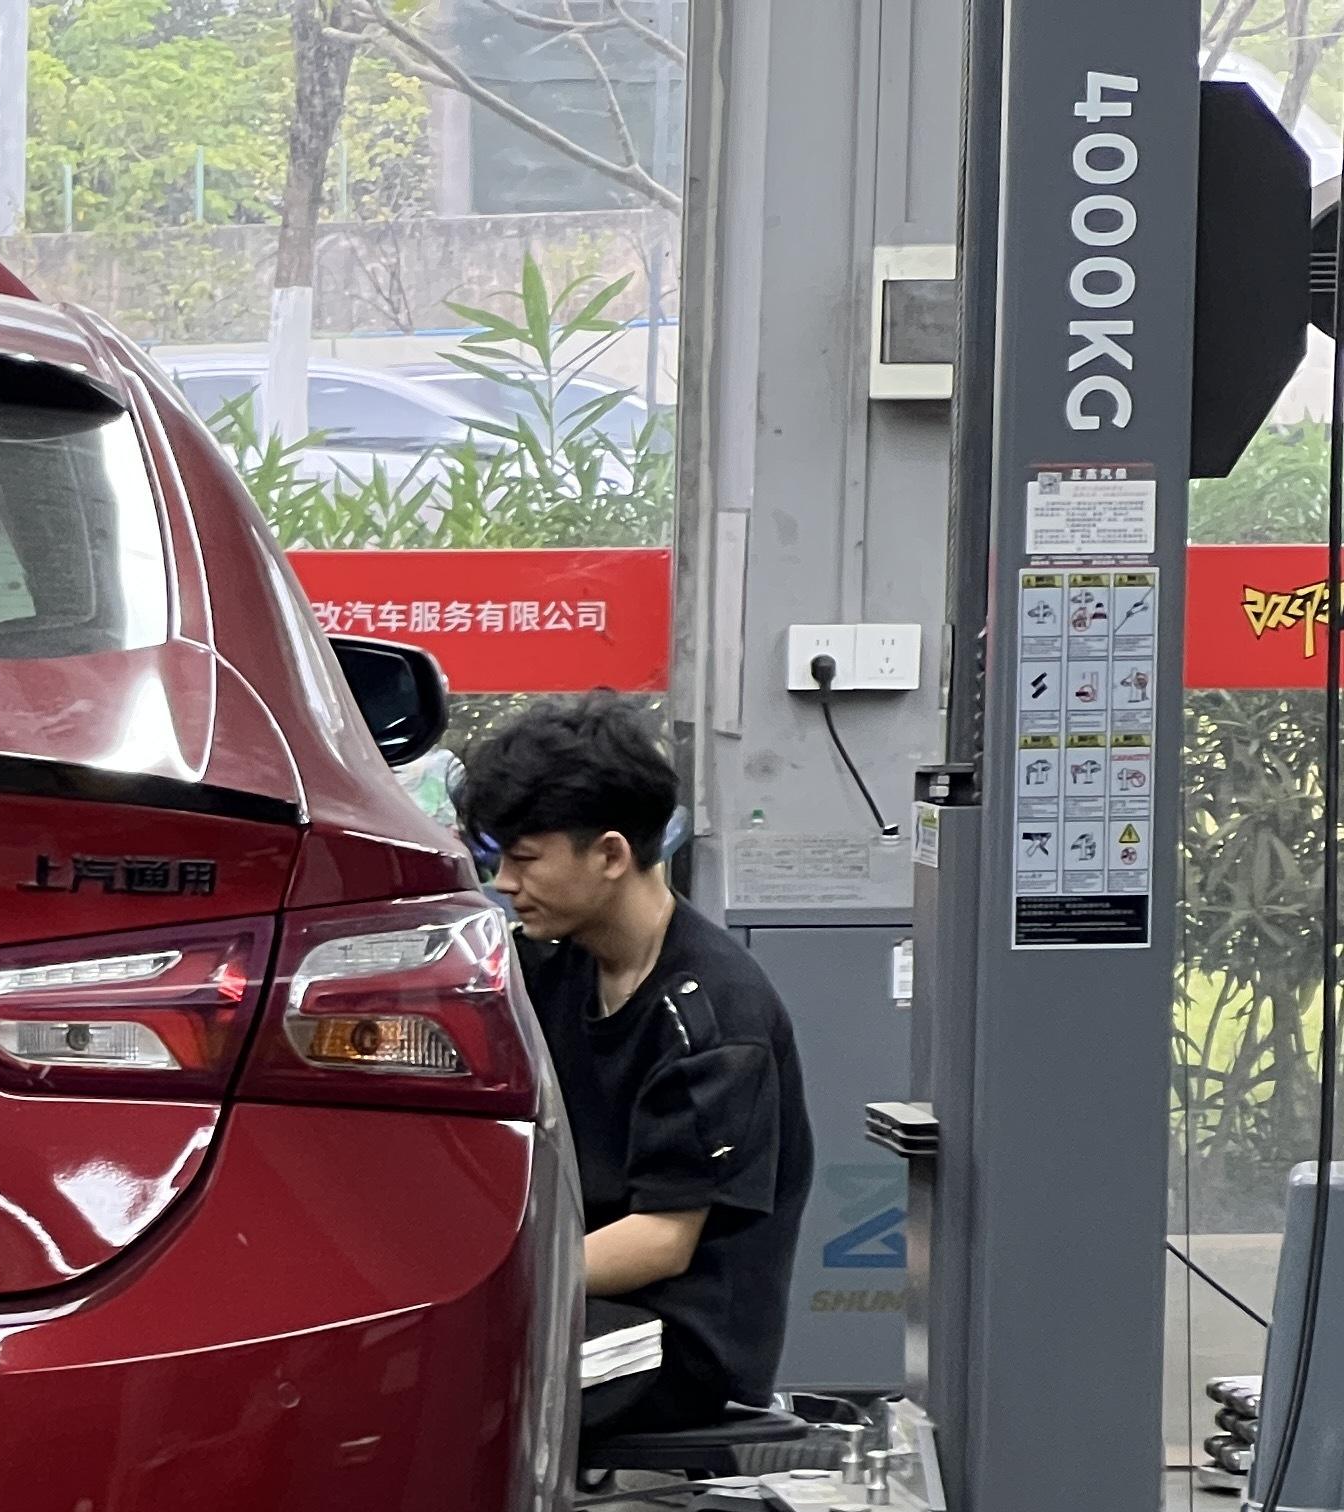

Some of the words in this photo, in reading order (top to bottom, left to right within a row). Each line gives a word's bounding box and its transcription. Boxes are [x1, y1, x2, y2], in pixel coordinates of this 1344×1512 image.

[1066, 71, 1138, 431] 4000KG
[16, 853, 217, 895] 上汽通用
